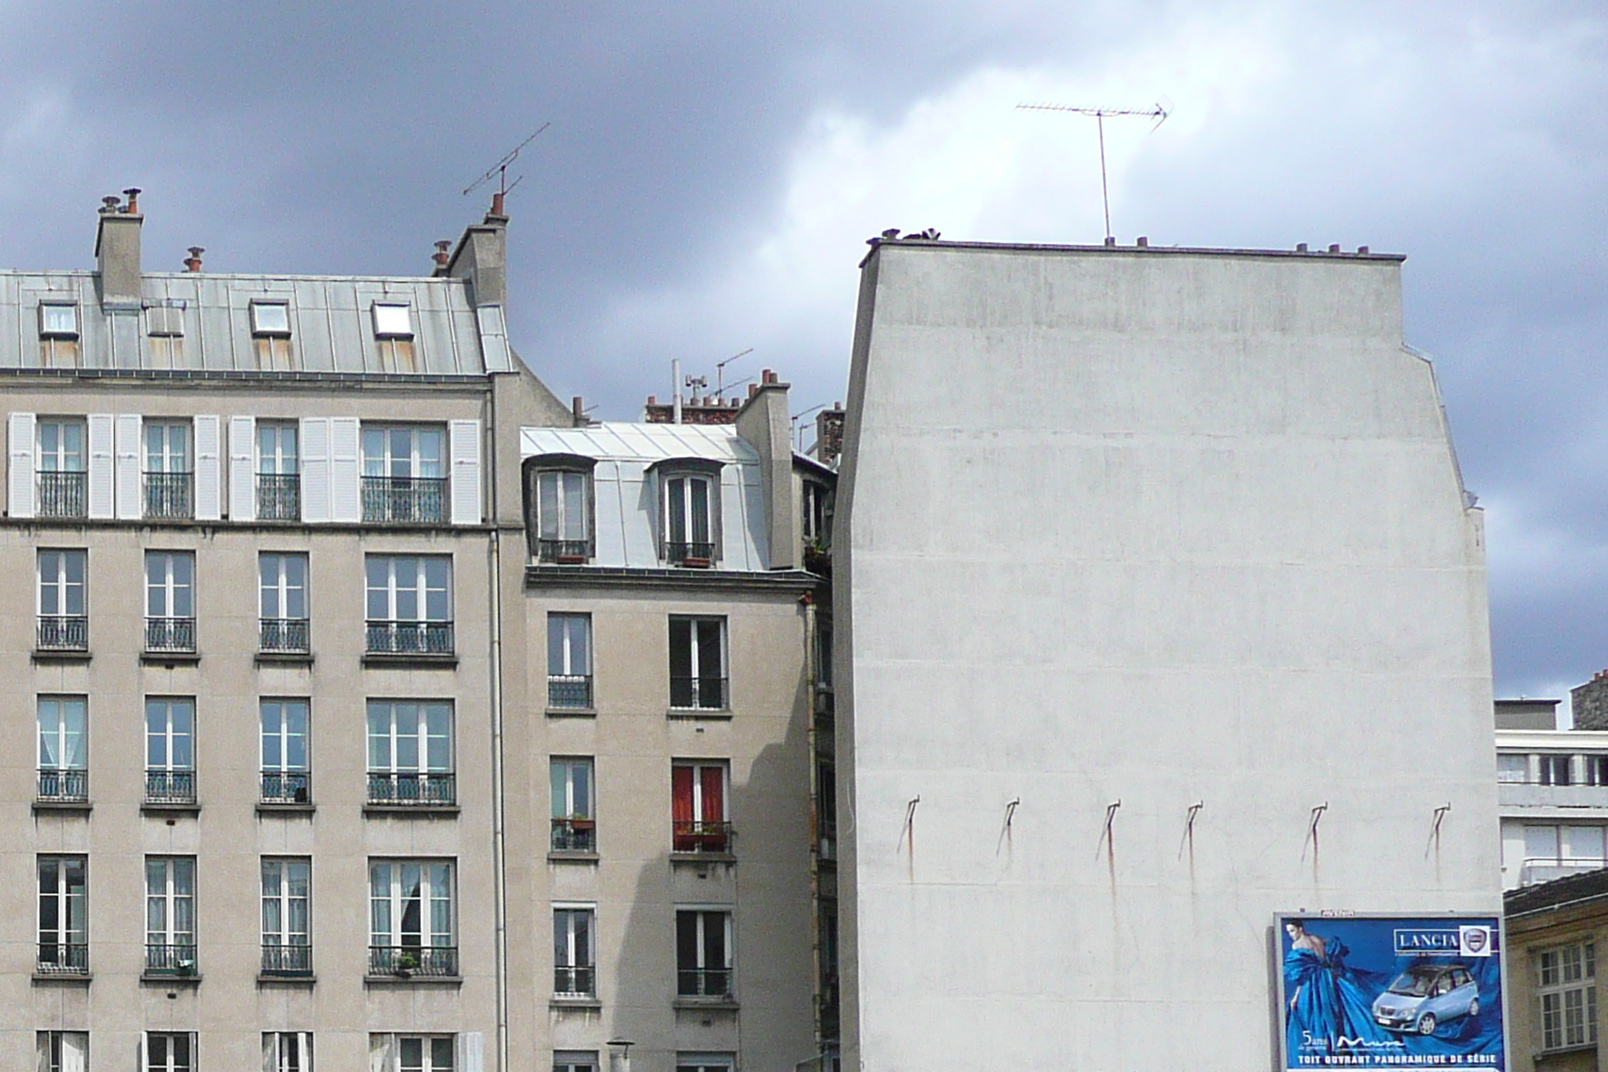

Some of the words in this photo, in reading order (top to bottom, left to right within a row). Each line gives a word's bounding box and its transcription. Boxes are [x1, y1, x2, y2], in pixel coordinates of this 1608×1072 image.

[1399, 934, 1458, 946] LANCIA
[1298, 1055, 1321, 1064] TOIT
[1324, 1055, 1371, 1064] OUVRANT
[1374, 1055, 1446, 1064] PANORAMIQUE
[1450, 1055, 1463, 1063] DE
[1467, 1053, 1497, 1063] SÉRIE
